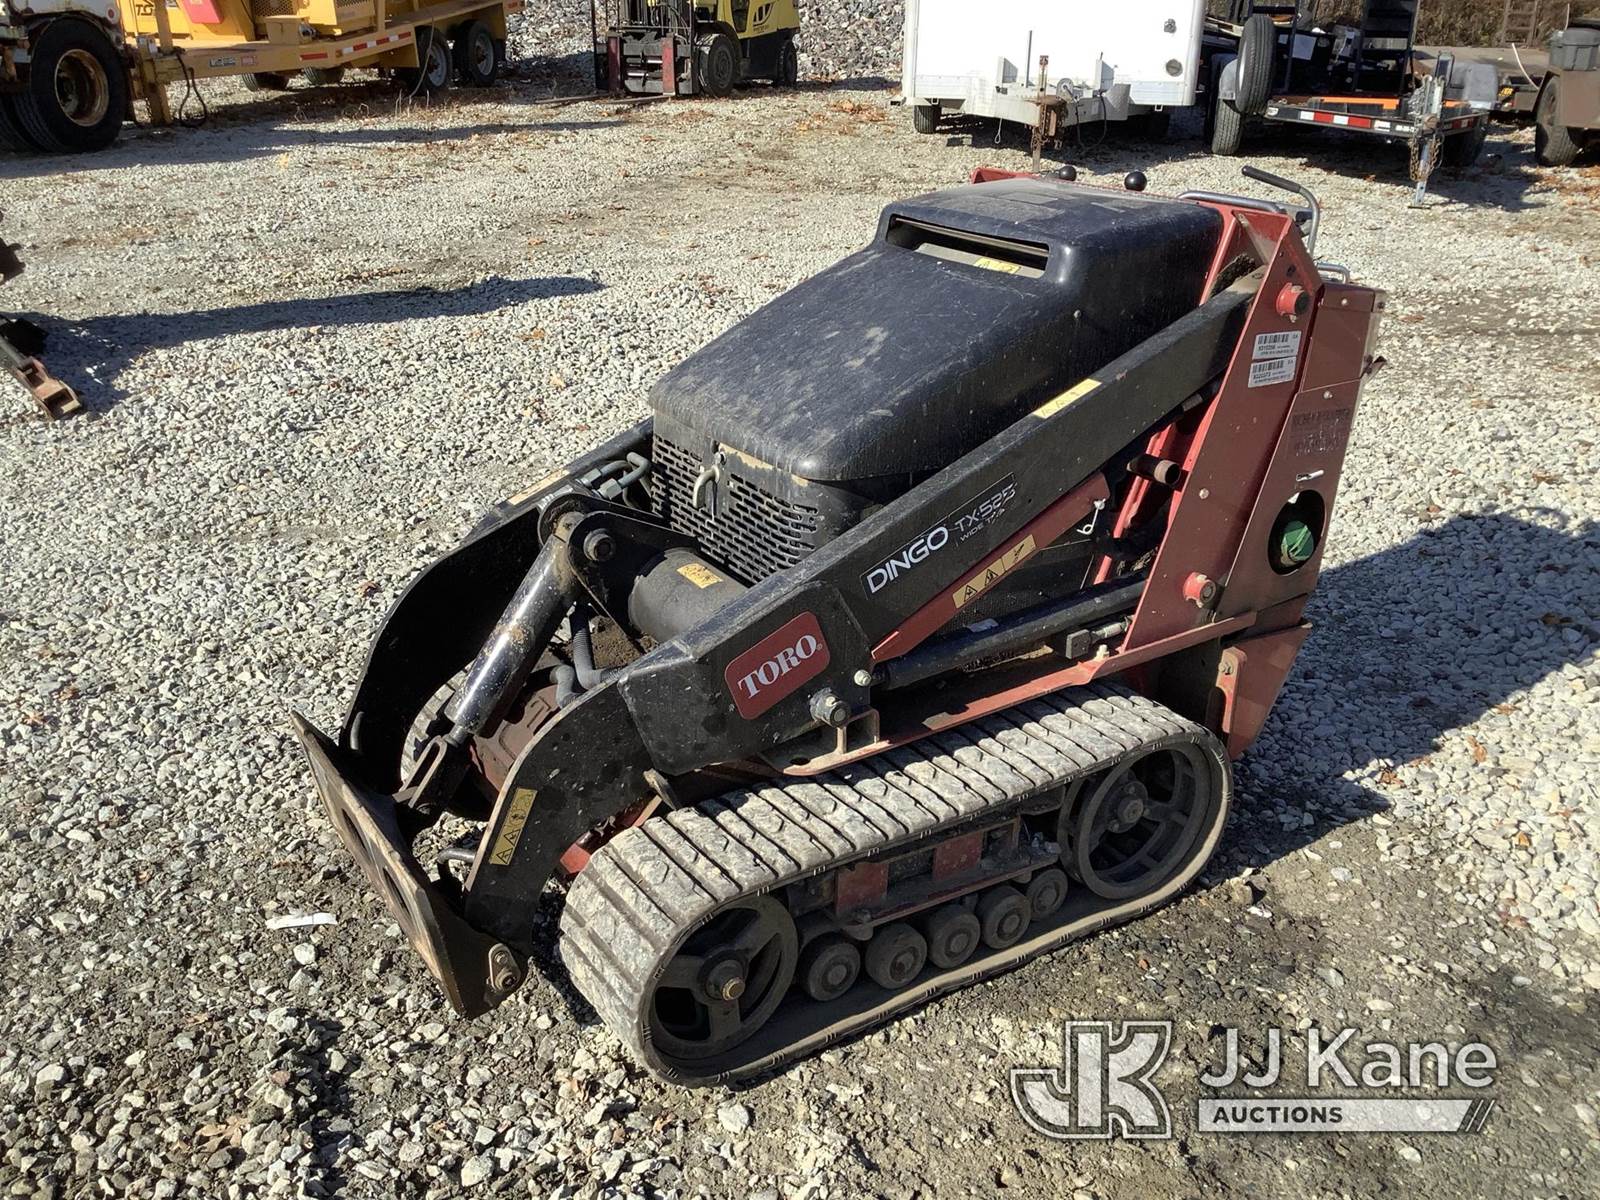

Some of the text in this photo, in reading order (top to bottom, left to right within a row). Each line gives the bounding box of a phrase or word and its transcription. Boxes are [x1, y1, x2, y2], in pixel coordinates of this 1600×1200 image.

[866, 526, 949, 593] DINGO
[960, 524, 985, 542] WIDE
[737, 634, 818, 699] TORO
